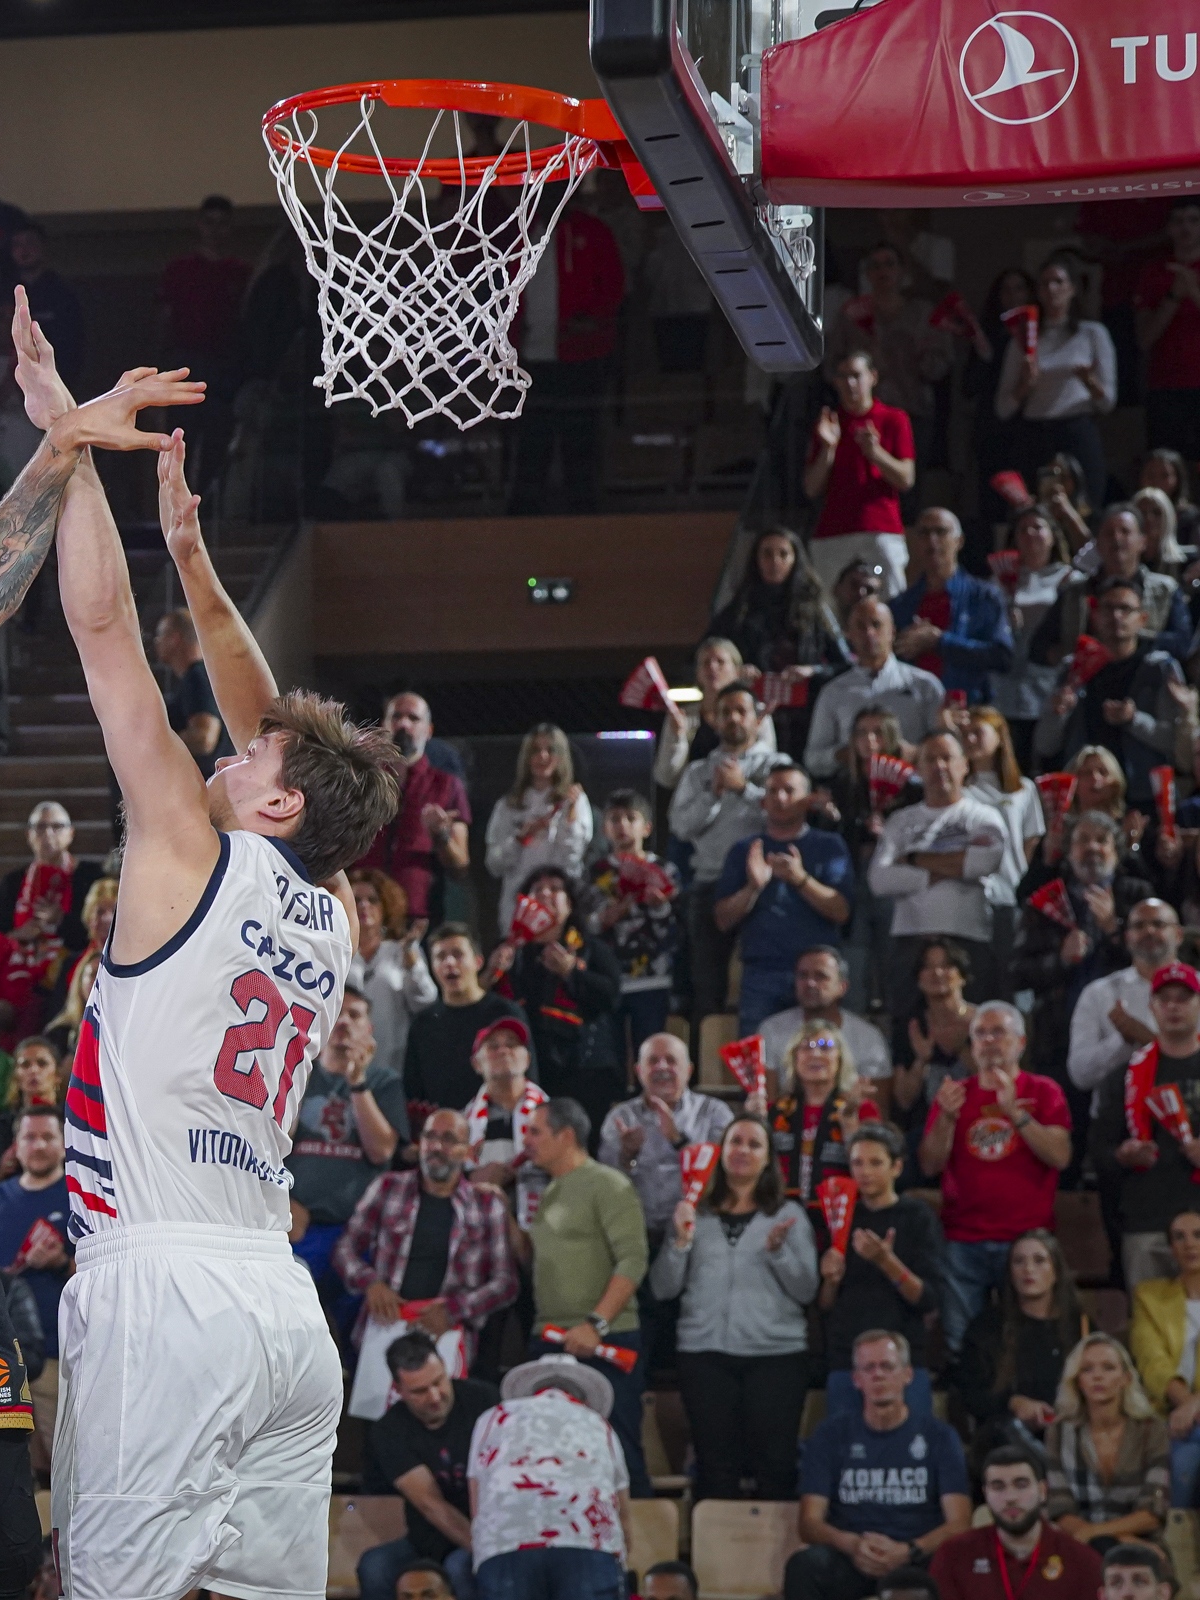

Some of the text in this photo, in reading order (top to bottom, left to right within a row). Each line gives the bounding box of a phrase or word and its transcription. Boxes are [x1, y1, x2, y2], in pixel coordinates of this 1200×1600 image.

[1111, 33, 1198, 84] TU
[273, 870, 334, 932] OTSAR
[240, 919, 335, 1000] CAZOO
[213, 968, 317, 1128] 21
